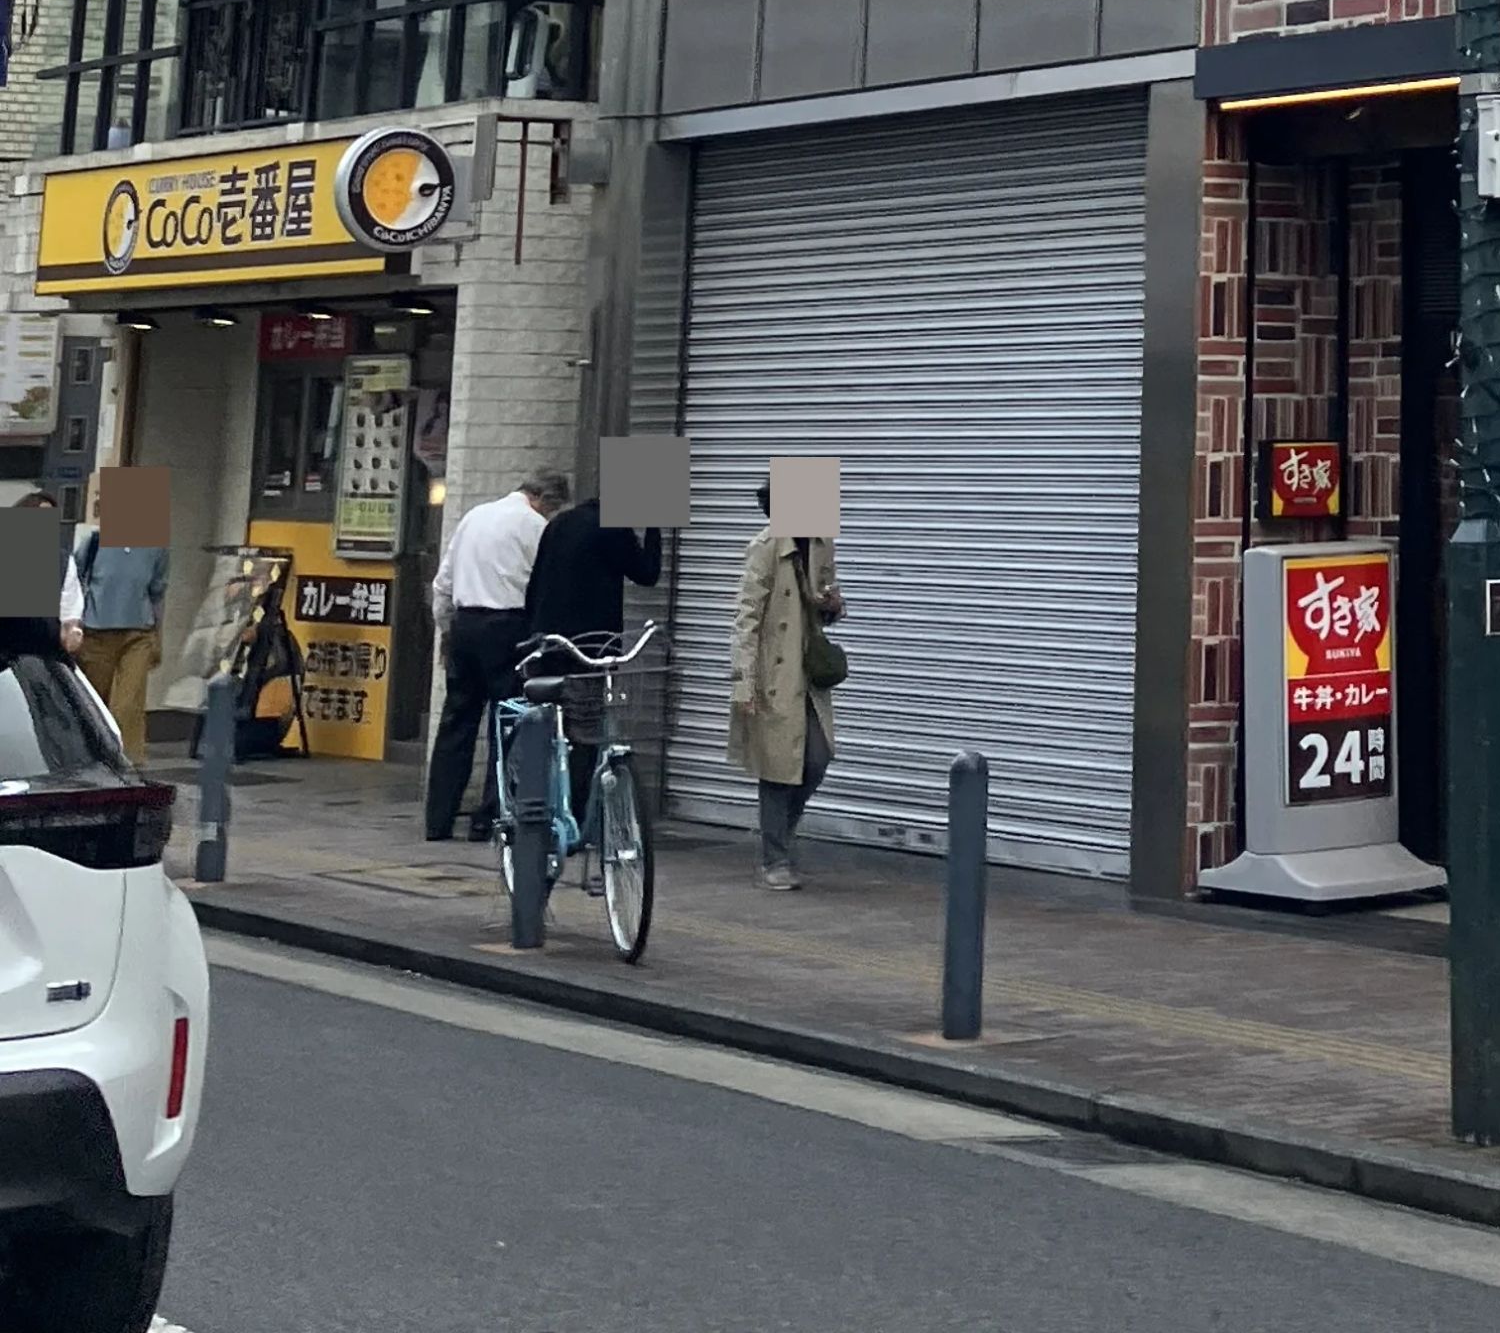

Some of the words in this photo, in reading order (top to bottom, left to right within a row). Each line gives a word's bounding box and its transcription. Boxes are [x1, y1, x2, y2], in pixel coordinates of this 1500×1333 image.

[146, 159, 317, 250] CoCo壱番屋
[1279, 448, 1332, 495] すき家
[302, 581, 387, 623] カレー弁当
[1297, 571, 1381, 644] すき家
[1293, 683, 1388, 711] 牛丼・カレー
